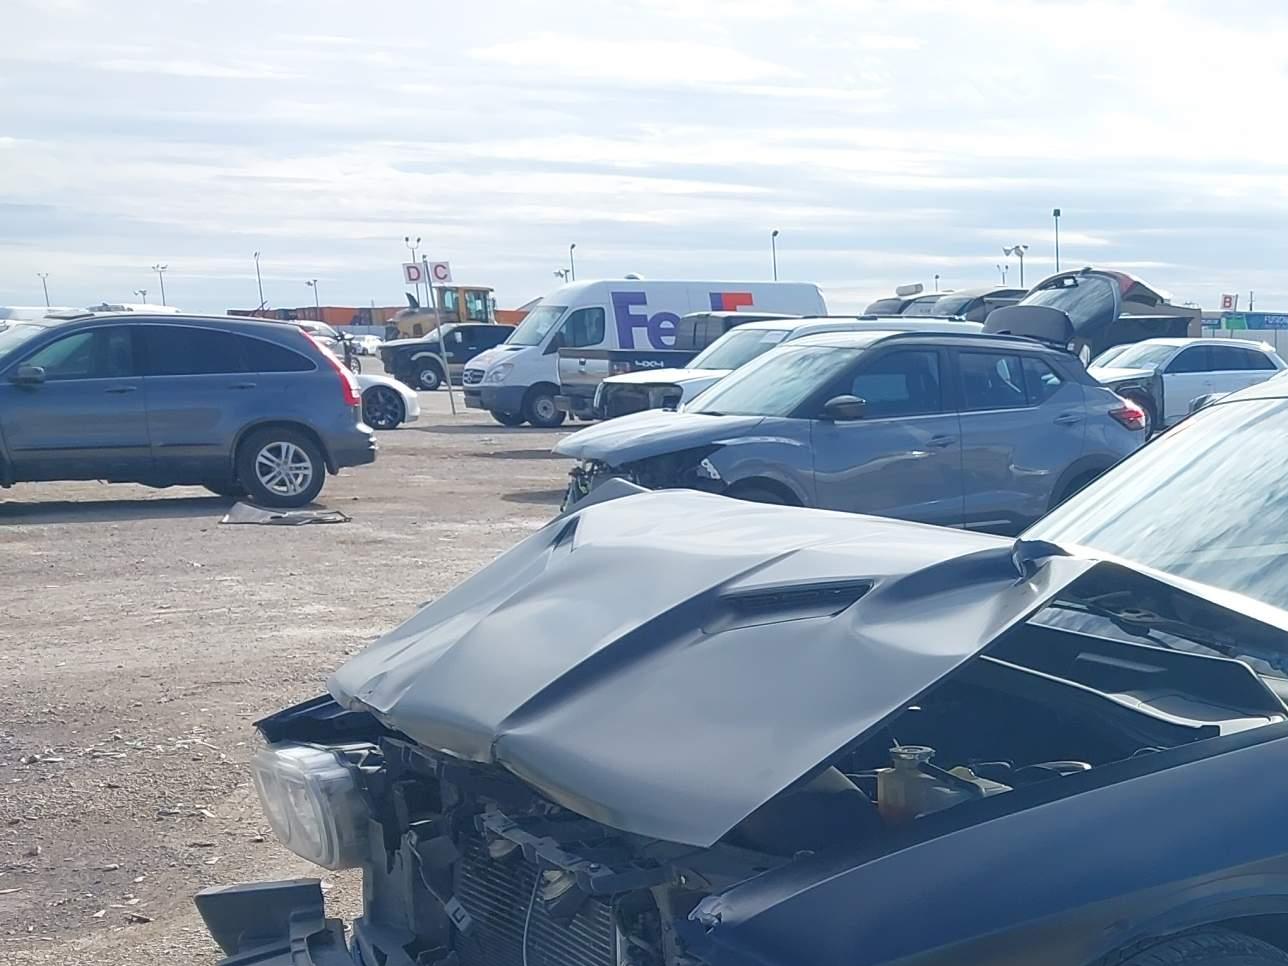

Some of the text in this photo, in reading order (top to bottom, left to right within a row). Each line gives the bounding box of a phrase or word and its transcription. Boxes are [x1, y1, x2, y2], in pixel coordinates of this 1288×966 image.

[406, 266, 420, 281] D
[434, 264, 448, 280] C
[1223, 296, 1232, 308] B
